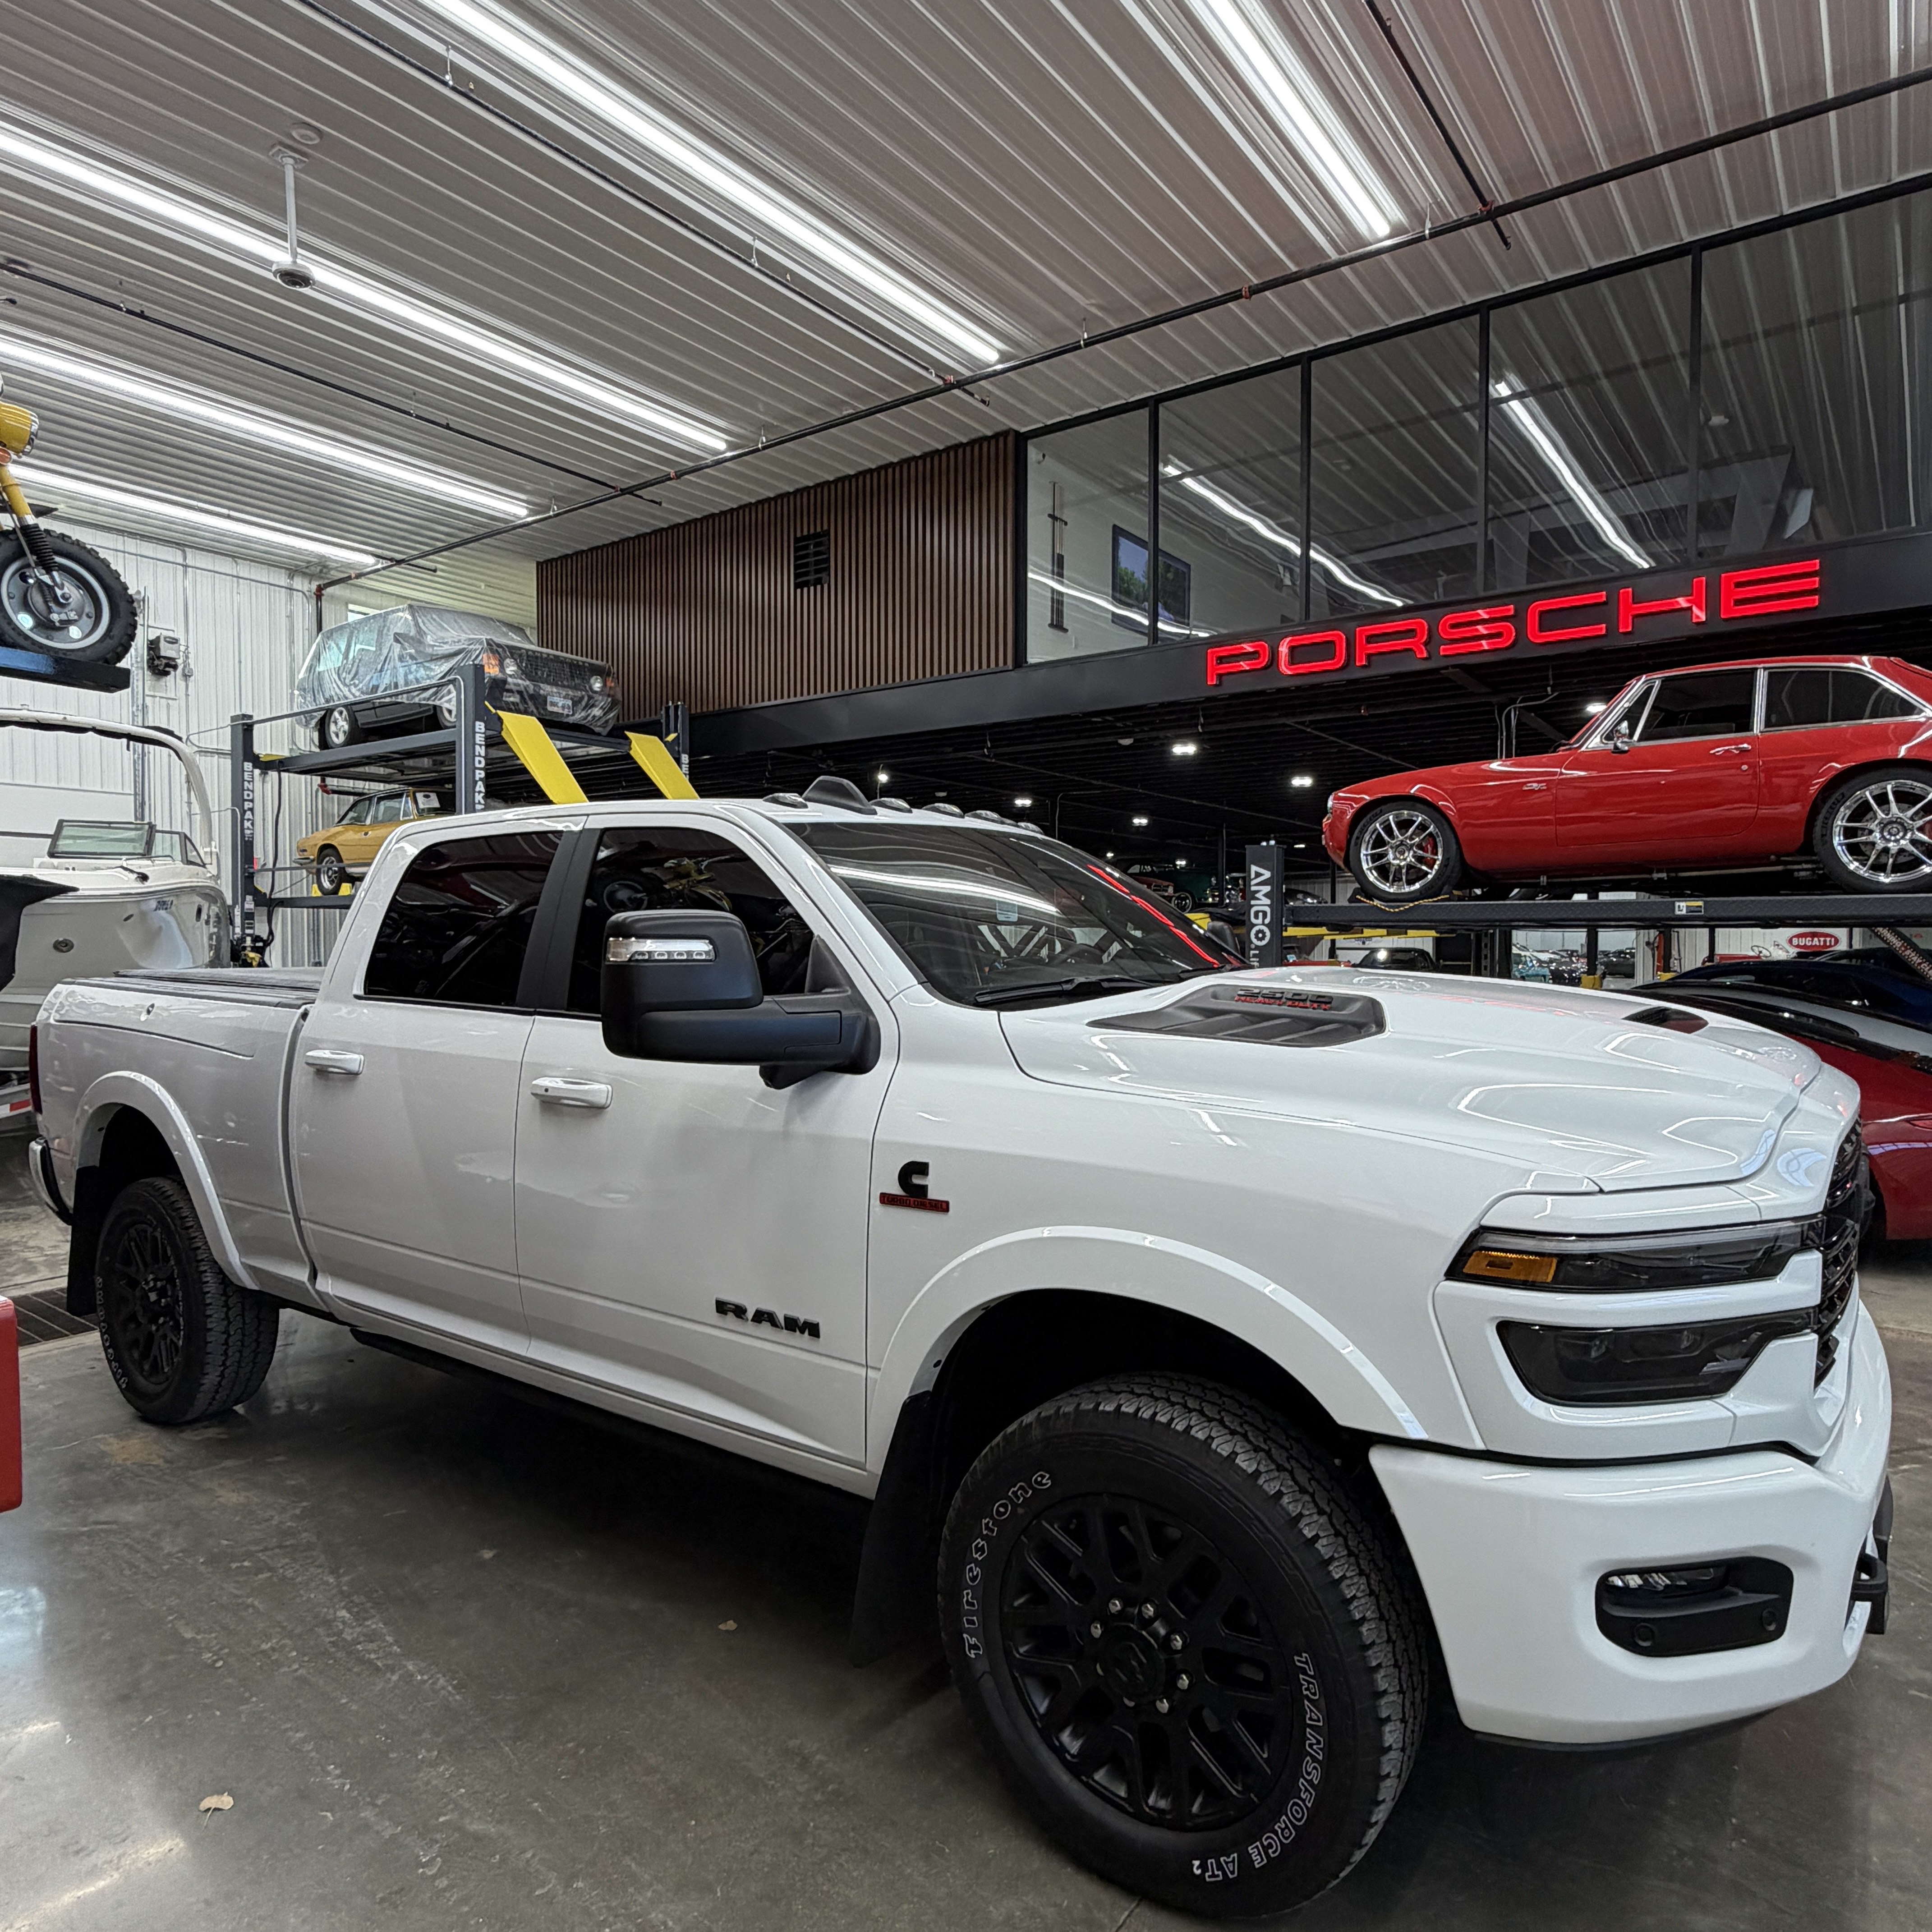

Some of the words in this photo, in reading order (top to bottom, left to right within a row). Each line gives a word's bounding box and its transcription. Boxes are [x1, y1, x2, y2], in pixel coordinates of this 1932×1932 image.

[1206, 559, 1821, 686] PORSCHE
[244, 762, 253, 829] BENDPAK
[475, 722, 485, 804] BENDPAK
[1250, 865, 1271, 946] AMGO
[1792, 938, 1835, 946] BUGATTI
[1237, 988, 1334, 1004] 2500
[715, 1297, 820, 1339] RAM
[1247, 1652, 1324, 1868] TRANSFORCE
